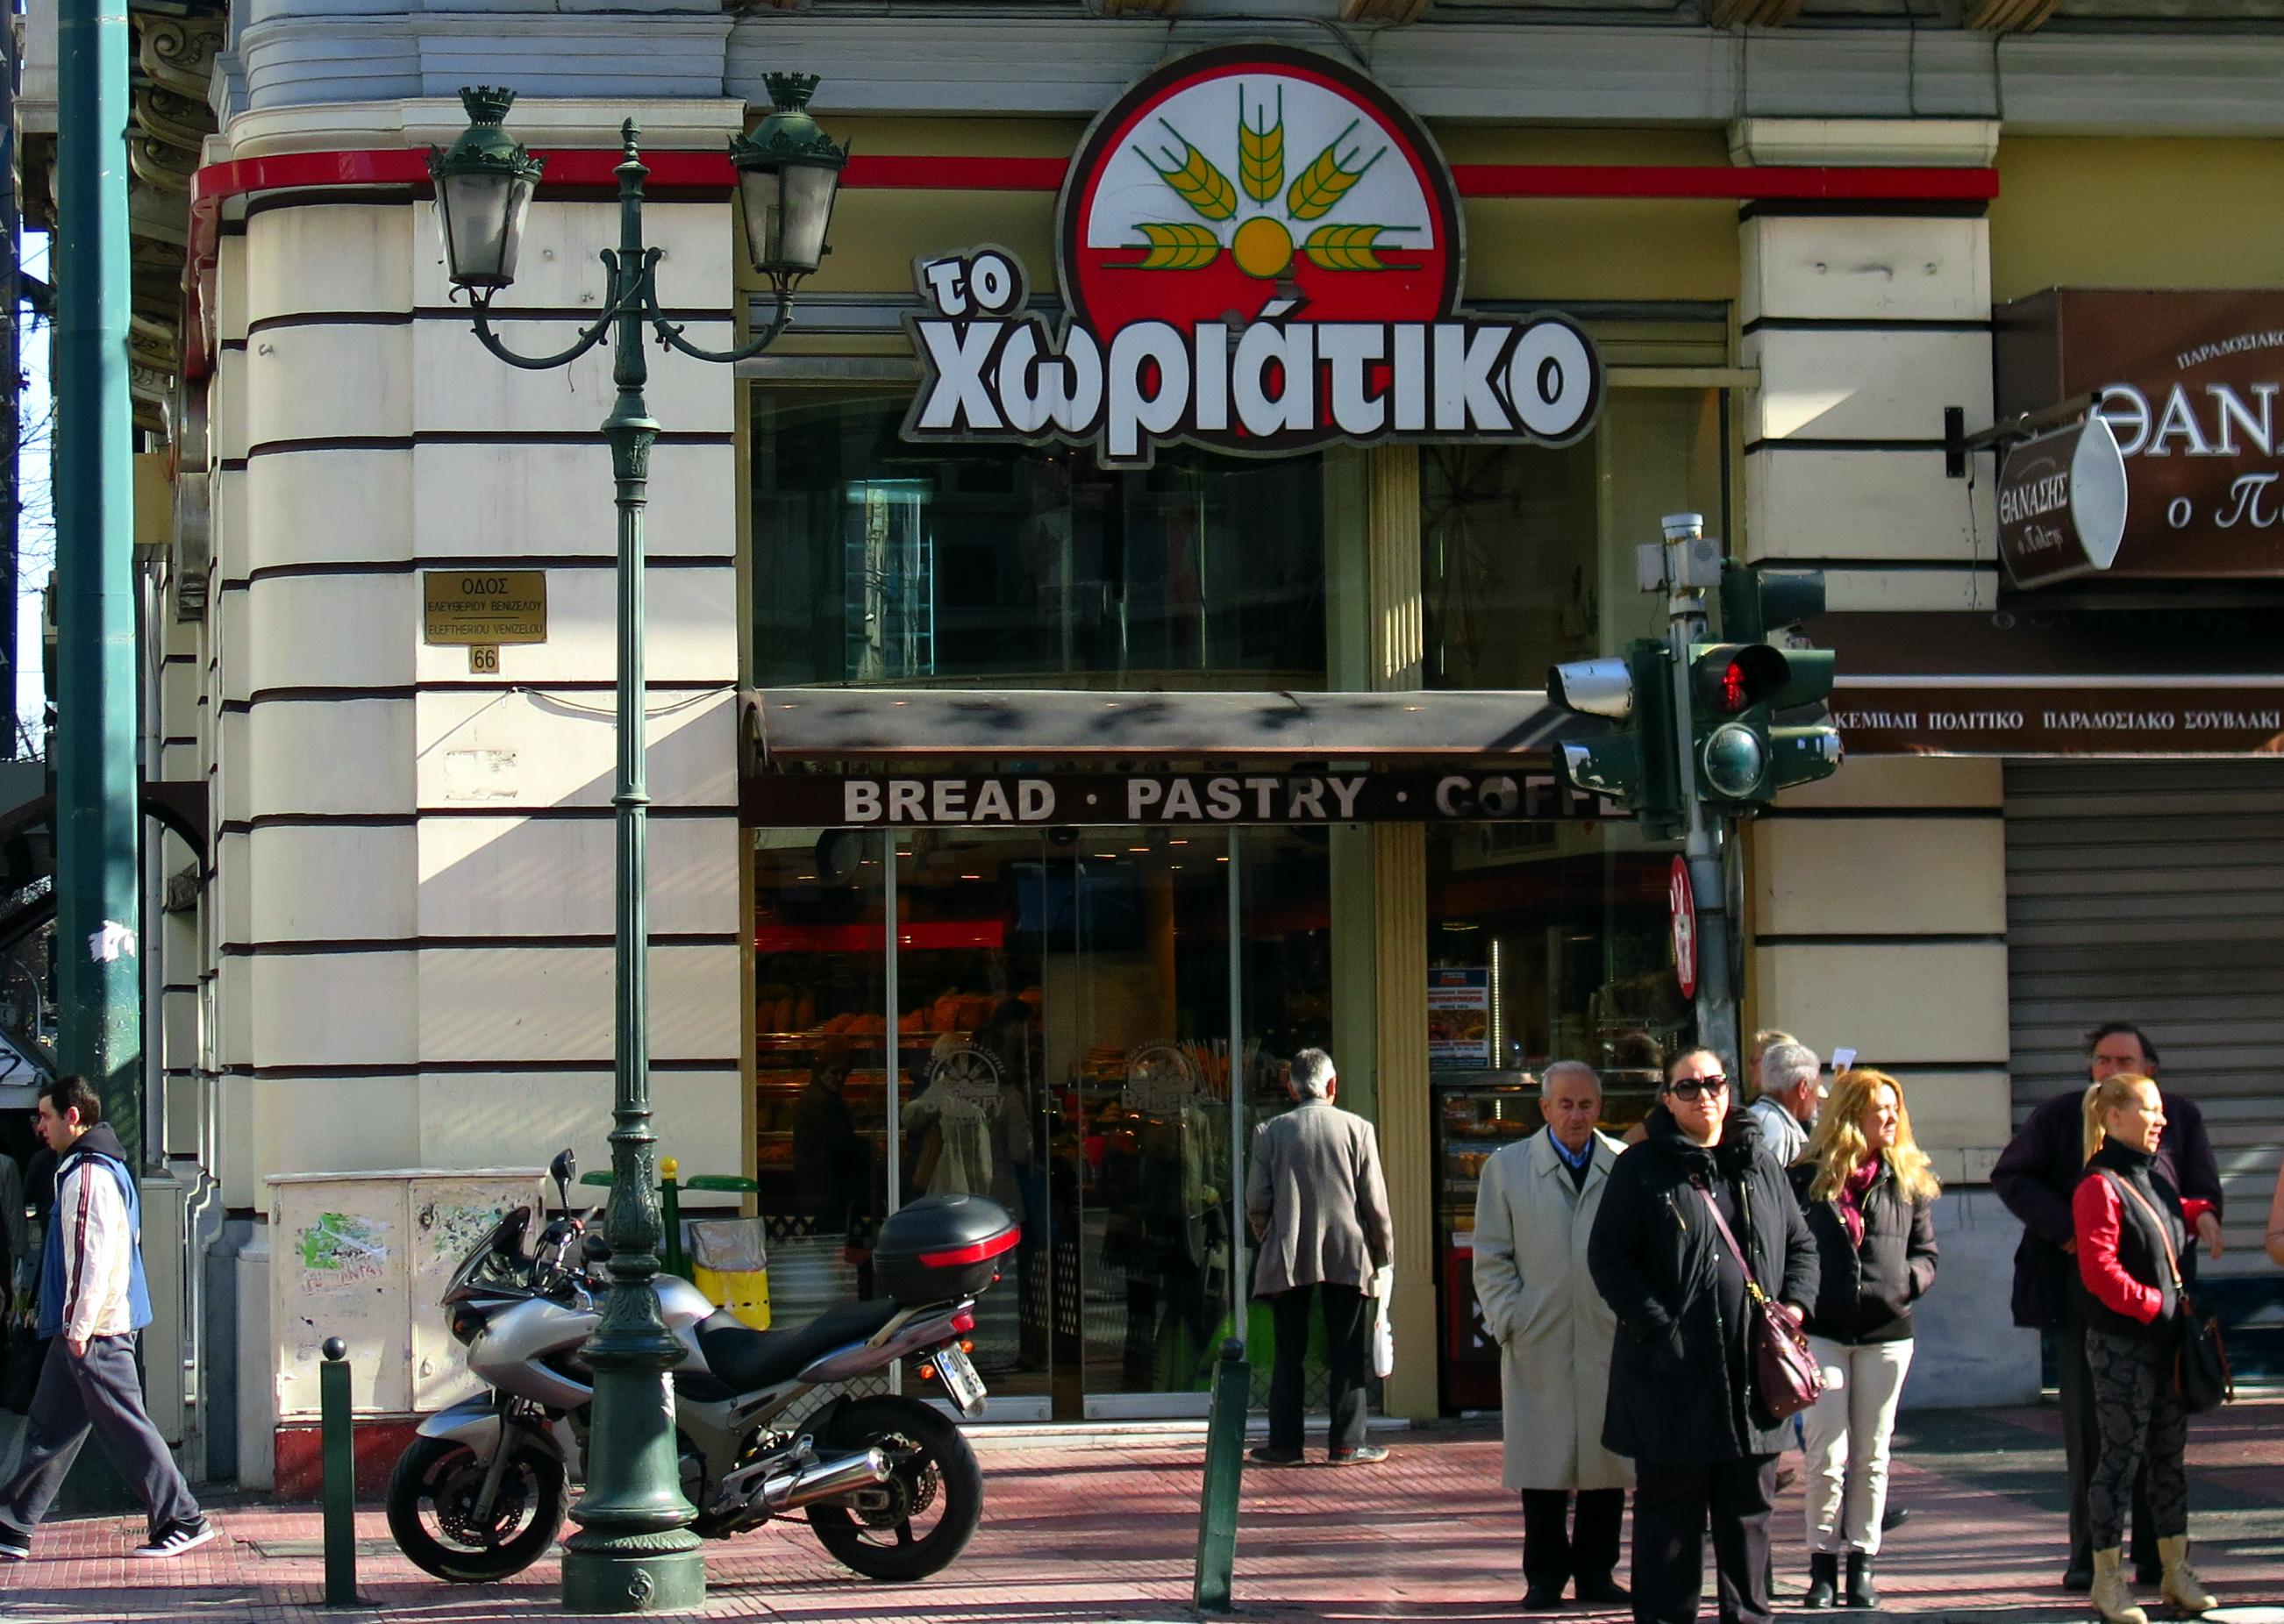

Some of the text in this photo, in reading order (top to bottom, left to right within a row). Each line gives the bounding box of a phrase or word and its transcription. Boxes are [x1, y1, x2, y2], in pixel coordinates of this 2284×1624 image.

[925, 253, 1011, 317] το
[2091, 381, 2284, 459] ΘΑΝ
[2001, 472, 2068, 524] ΘΑΝΑΣΗΣ
[461, 578, 509, 595] ΟΔΟΣ
[428, 600, 543, 612] ΕΛΕΥΘΕΡΙΟΥ ΒΕΝΙΖΕΛΟΥ
[428, 623, 543, 636] ELEFTHERIOU VENIZELOU
[475, 650, 496, 668] 66
[1928, 711, 2024, 730] ΠΟΛΙΤΙΚΟ
[2043, 710, 2175, 730] ΠΑΡΑΔΟΣΙΑΚΟ
[2183, 710, 2281, 730] ΣΟΥΒΛΑΚΙ
[843, 775, 1633, 823] BREAD PASTRY COFFE
